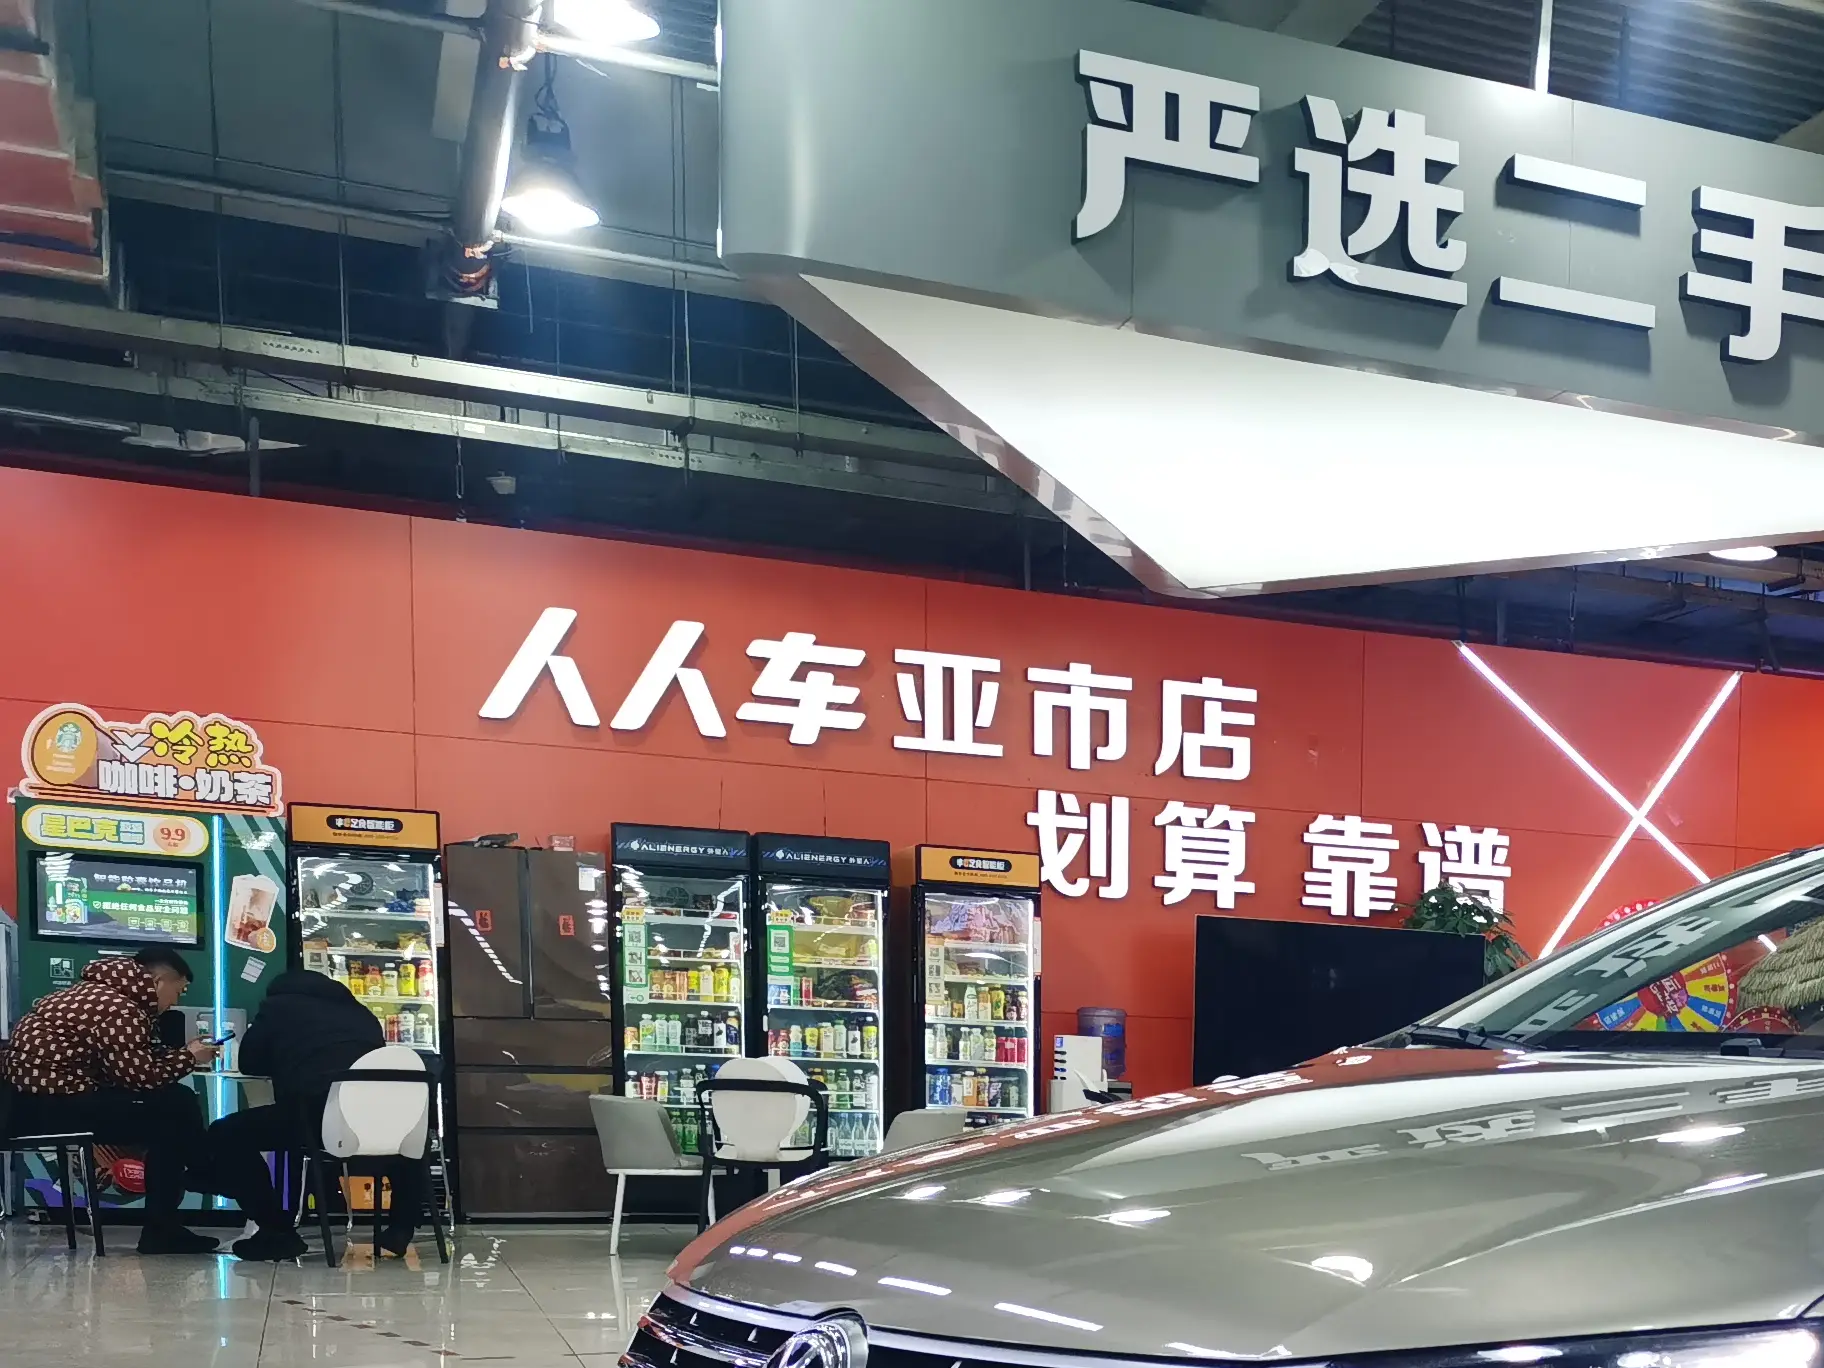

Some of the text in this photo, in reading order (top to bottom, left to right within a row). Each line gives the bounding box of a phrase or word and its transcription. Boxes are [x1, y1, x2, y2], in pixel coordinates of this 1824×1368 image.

[477, 606, 1258, 782] 人人车亚市店
[150, 719, 254, 768] 冷热
[641, 844, 705, 855] ALIENERGY
[785, 853, 847, 864] ALIENERGY
[1025, 789, 1512, 918] 划算 靠谱
